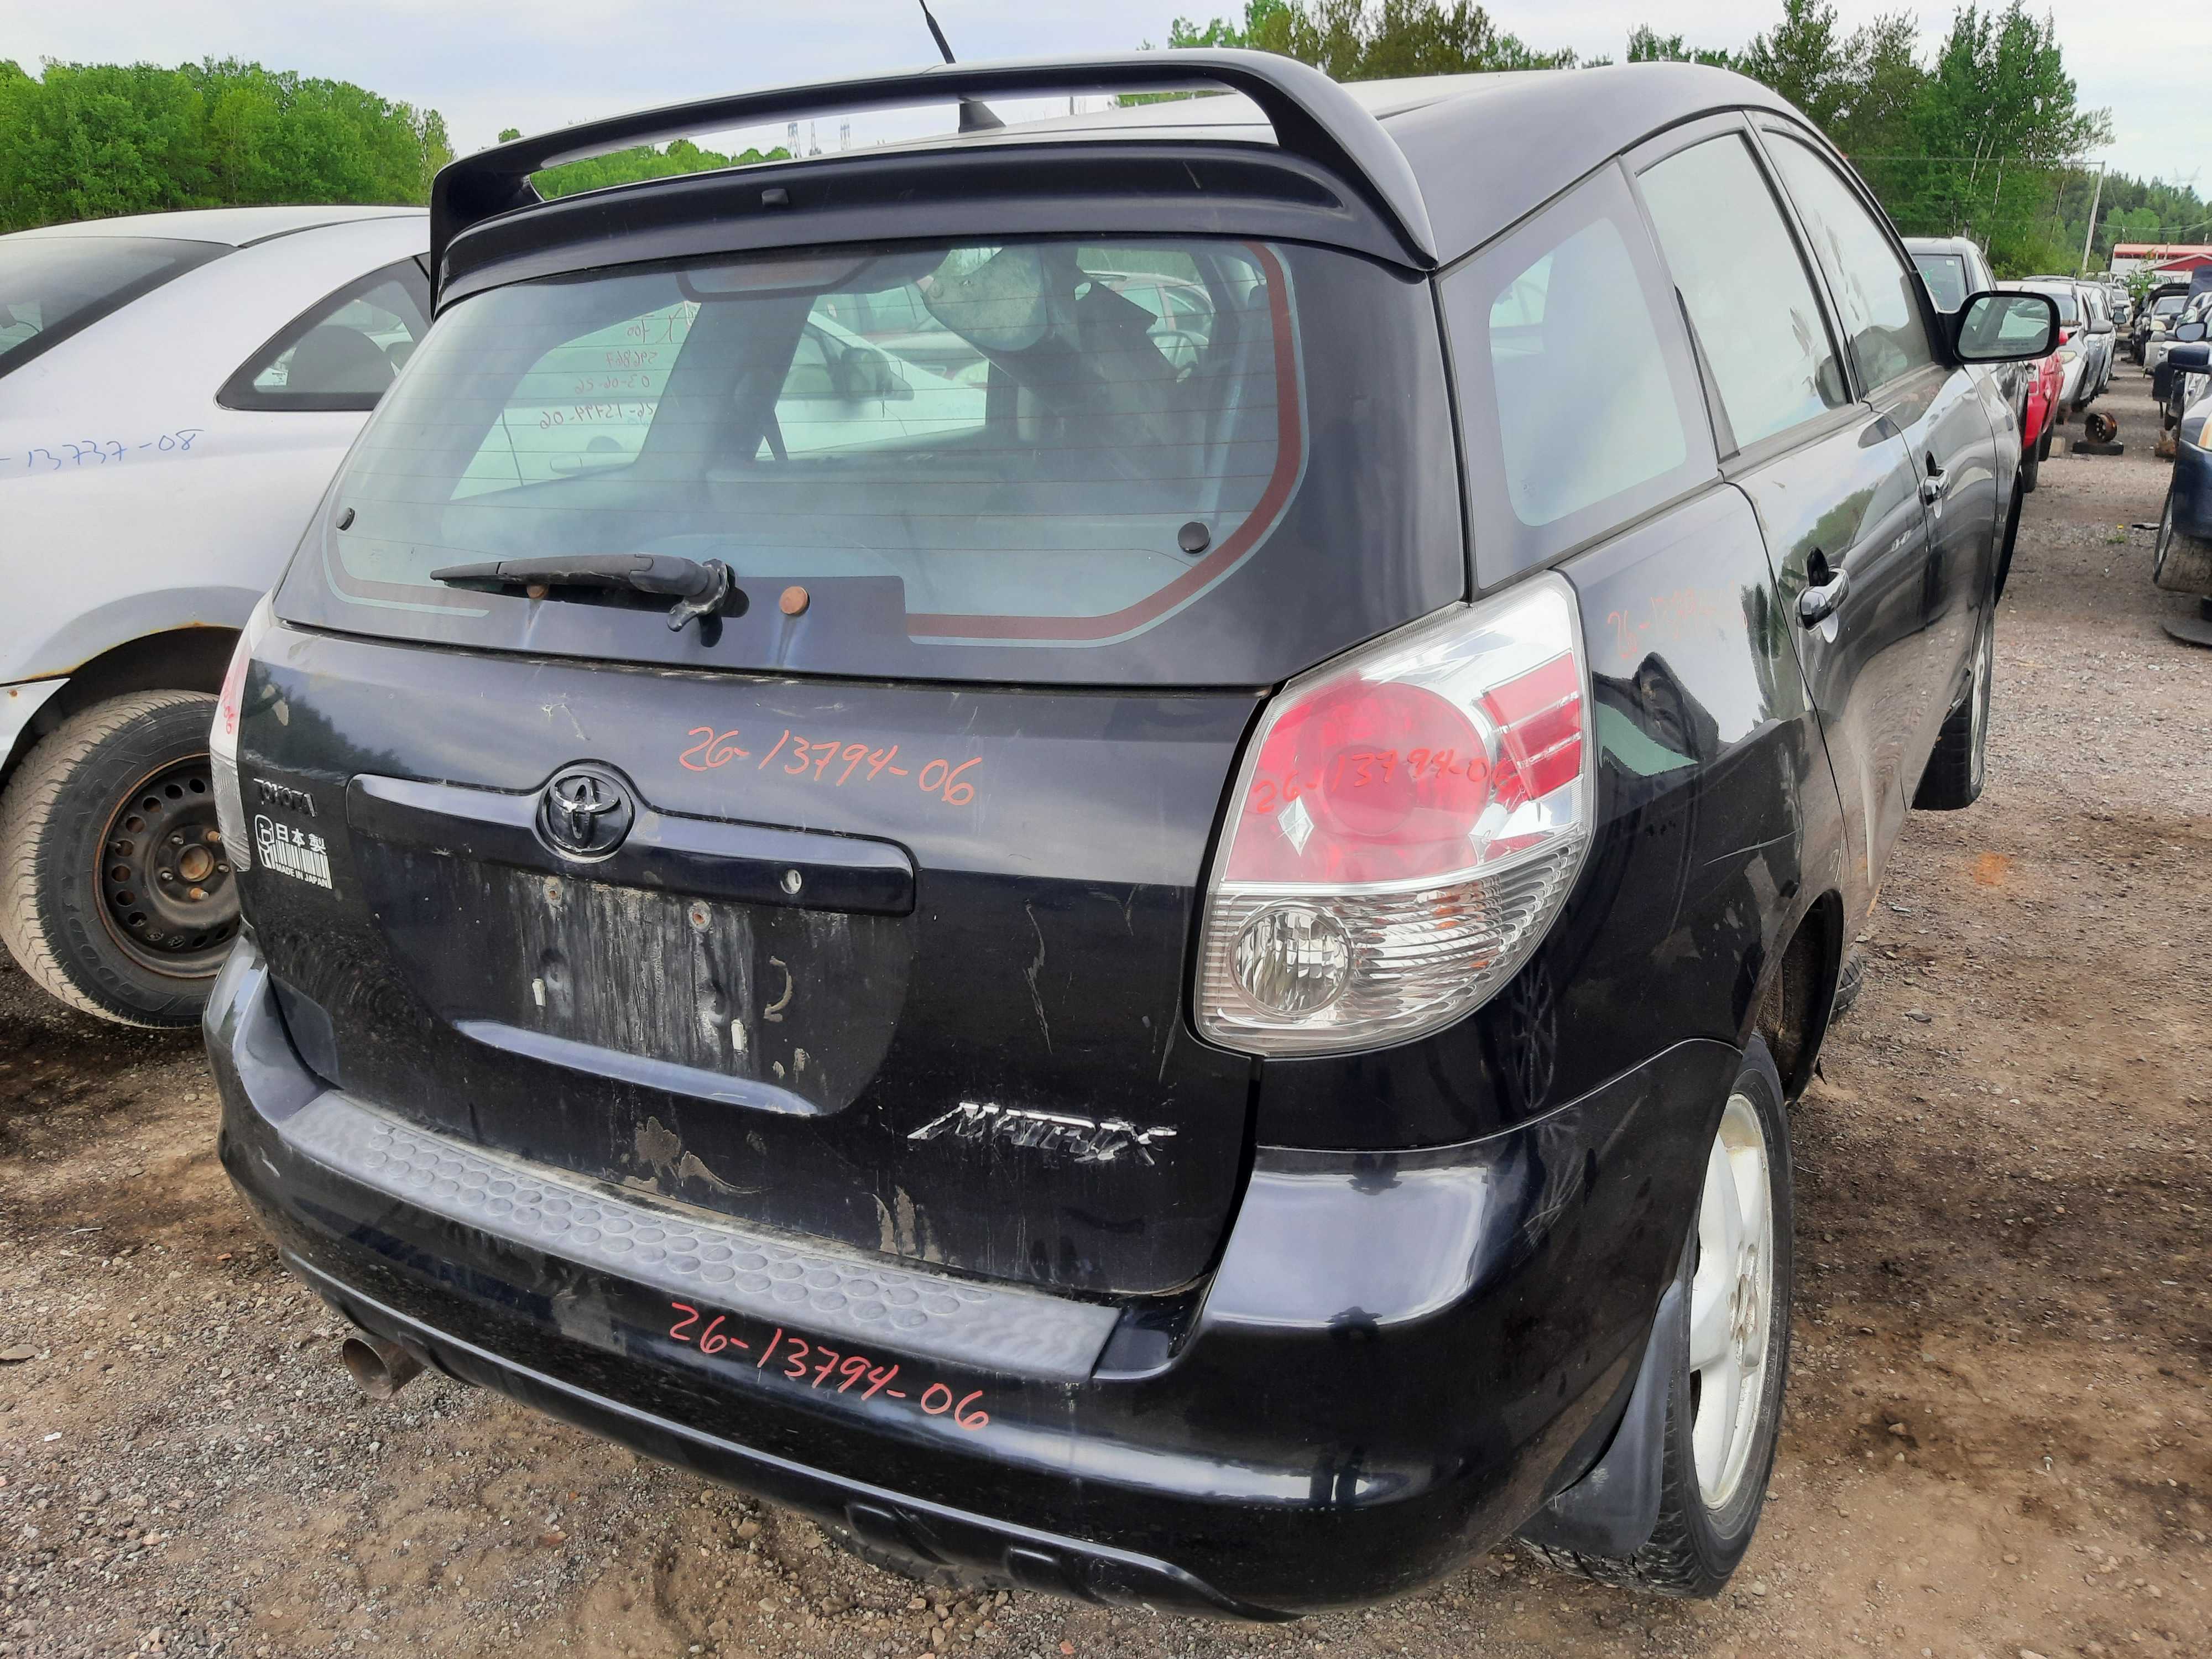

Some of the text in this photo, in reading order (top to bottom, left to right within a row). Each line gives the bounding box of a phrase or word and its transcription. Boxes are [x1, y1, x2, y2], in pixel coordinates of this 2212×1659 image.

[679, 726, 983, 806] 26-13794-06
[1253, 748, 1515, 813] 26-13794-06
[275, 822, 327, 855] 日本製
[275, 863, 328, 888] MADE IN JAPAN
[669, 1302, 990, 1431] 26-13794-06
